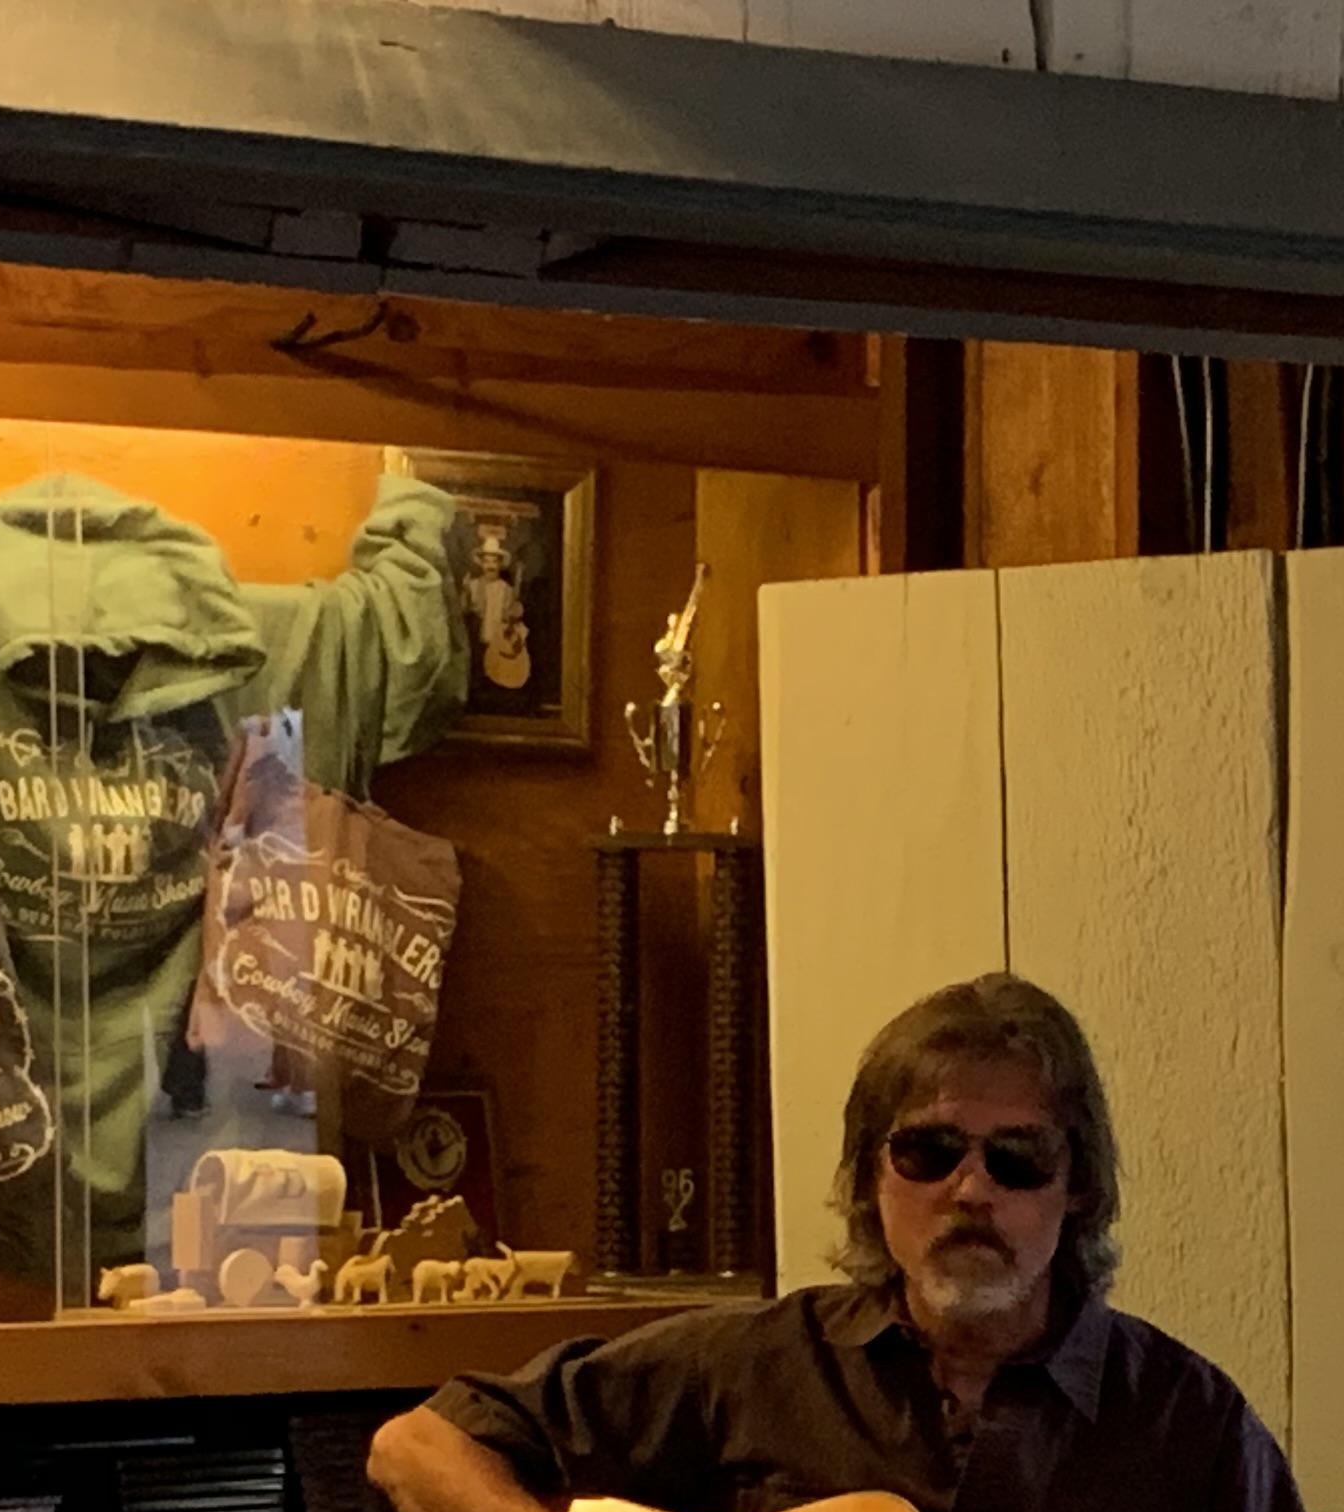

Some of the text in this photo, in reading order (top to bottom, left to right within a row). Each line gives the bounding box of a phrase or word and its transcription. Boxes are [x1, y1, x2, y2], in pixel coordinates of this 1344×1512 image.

[250, 876, 295, 920] BAR
[300, 881, 320, 922] D
[233, 951, 317, 1014] Cowboy
